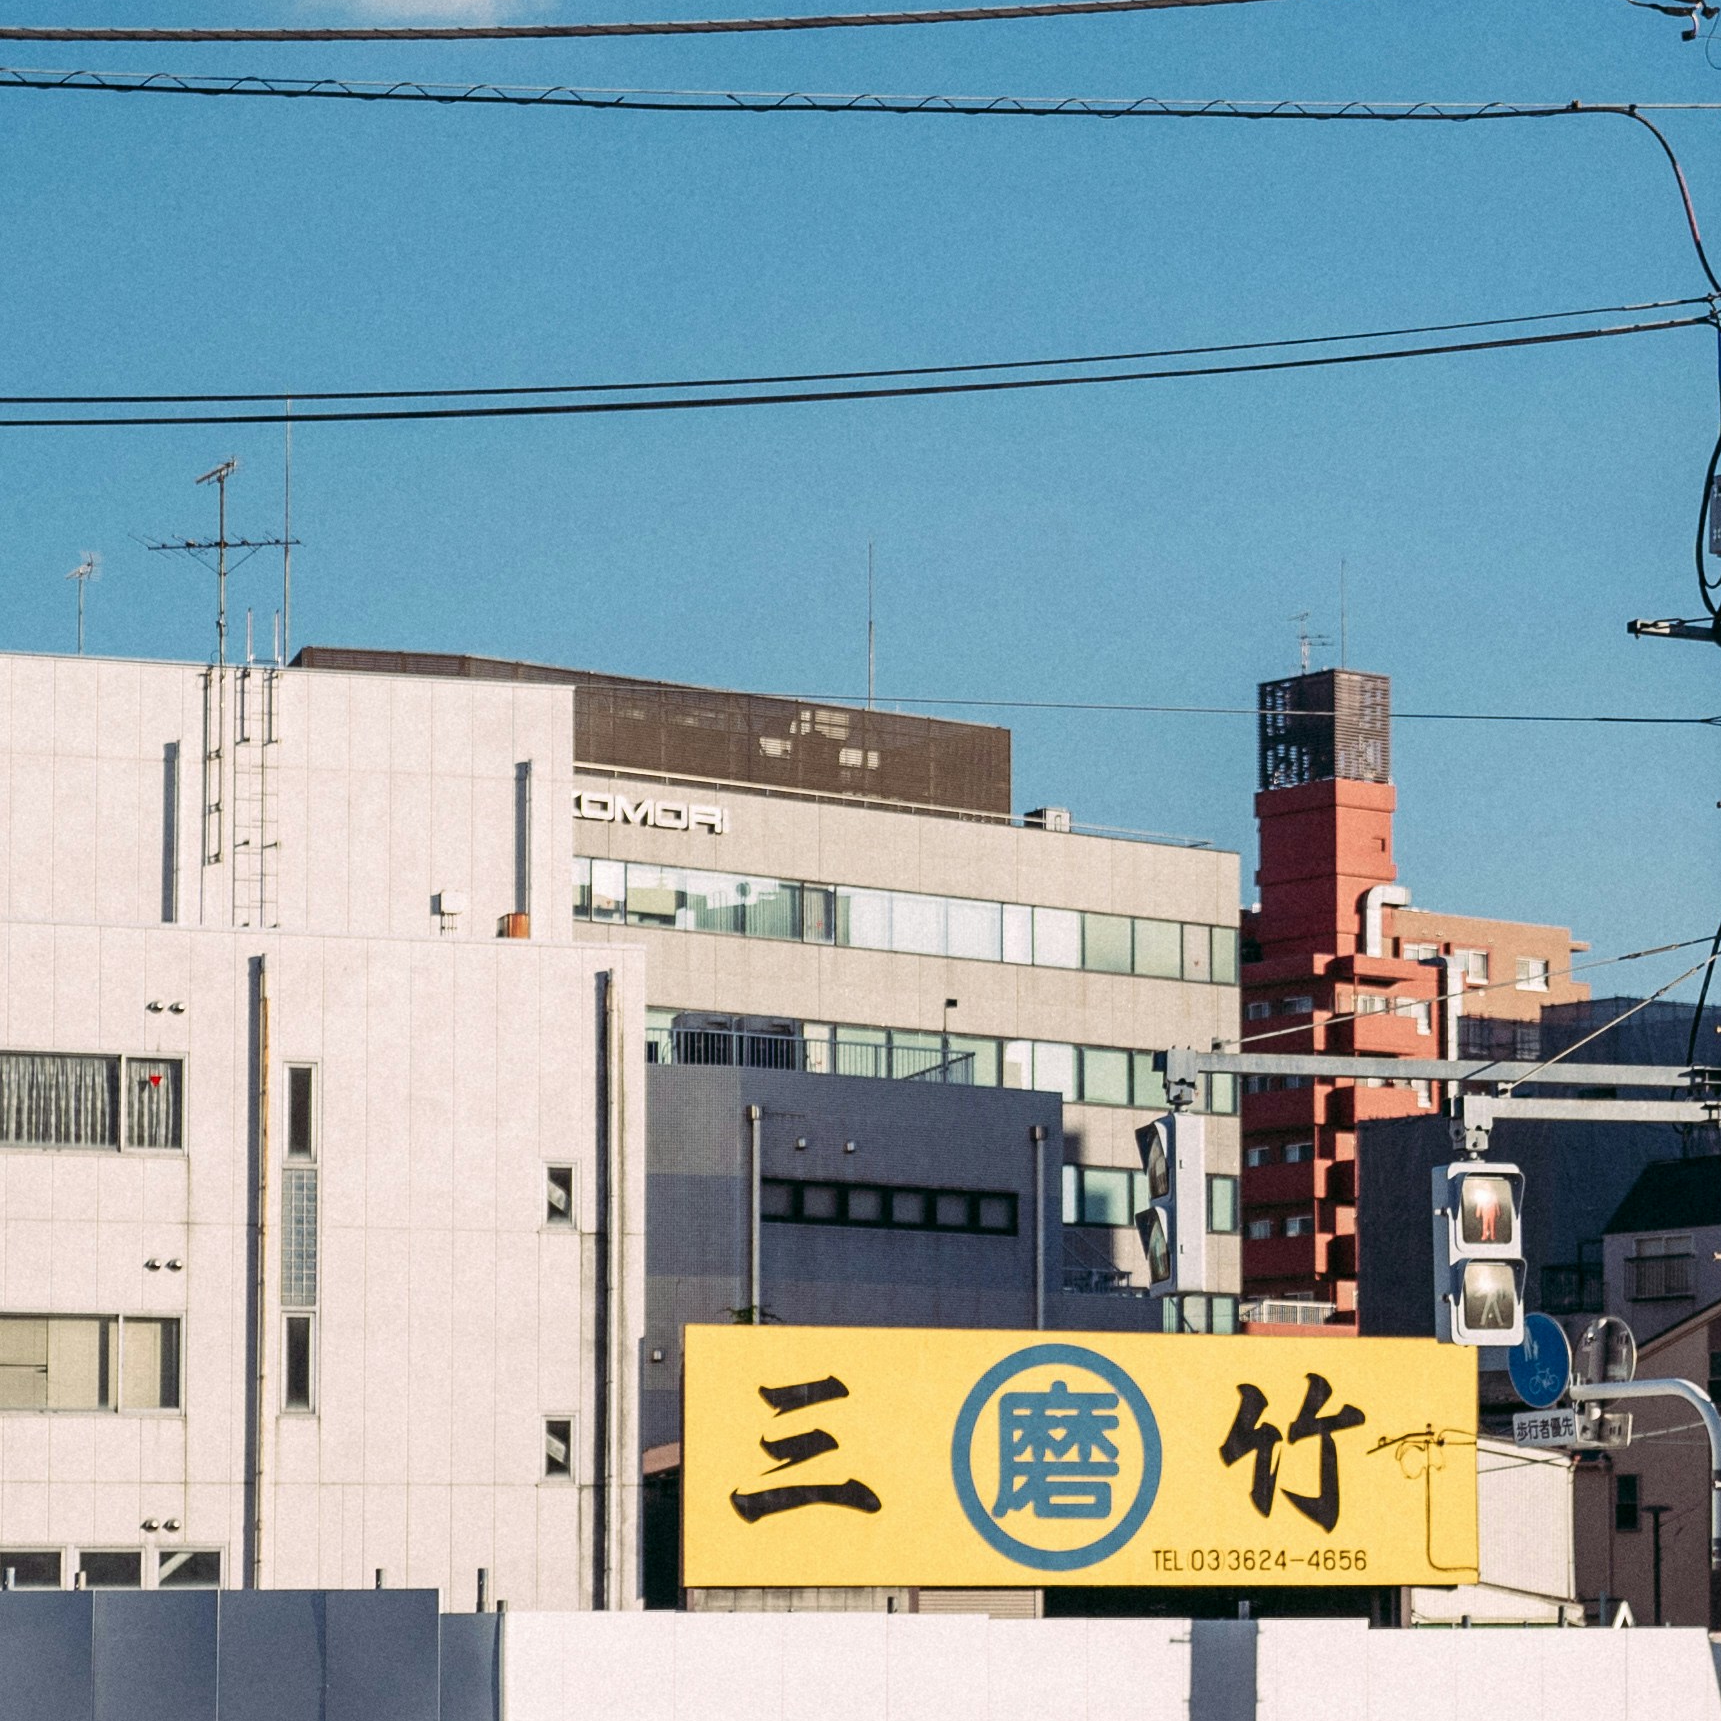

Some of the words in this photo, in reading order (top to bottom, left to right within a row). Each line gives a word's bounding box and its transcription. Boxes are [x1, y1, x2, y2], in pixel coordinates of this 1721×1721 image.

[1516, 1416, 1574, 1442] 歩行者優先
